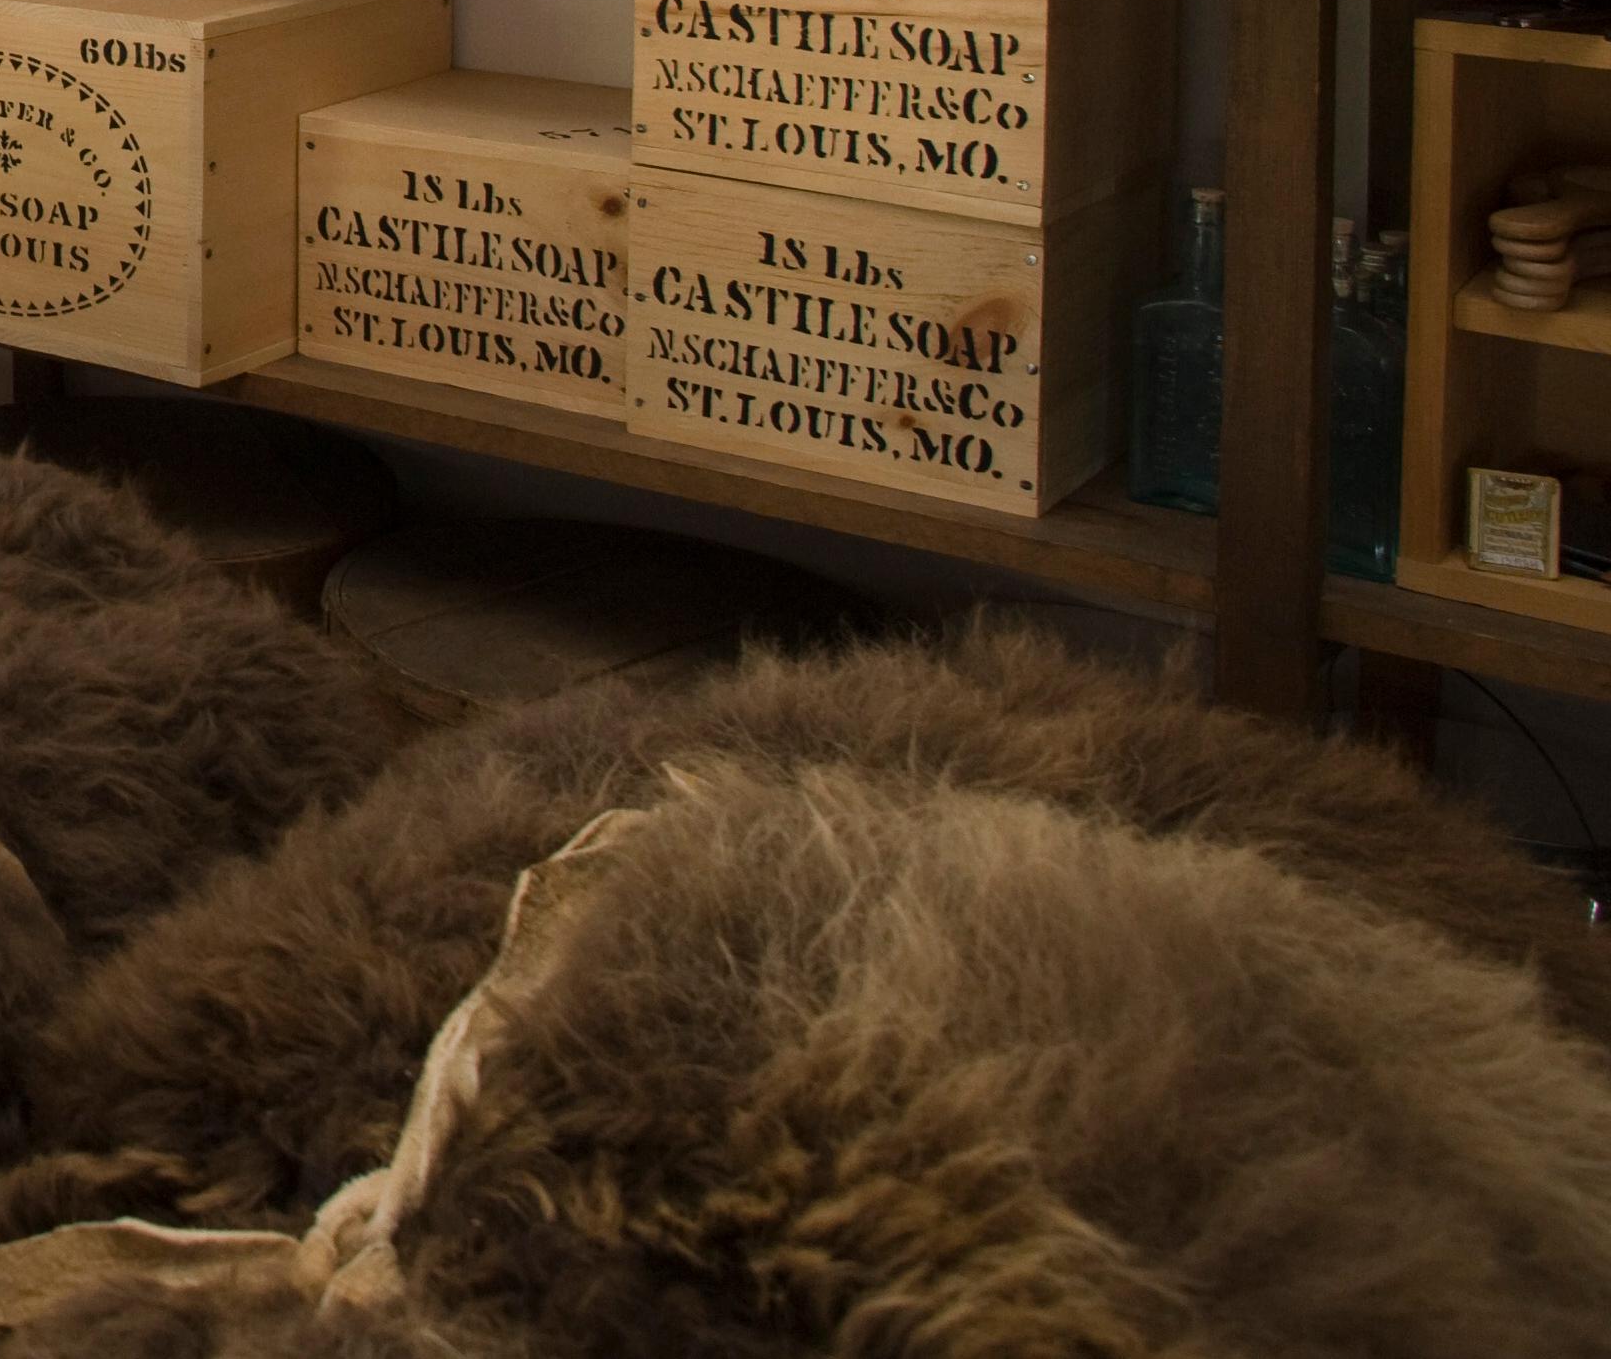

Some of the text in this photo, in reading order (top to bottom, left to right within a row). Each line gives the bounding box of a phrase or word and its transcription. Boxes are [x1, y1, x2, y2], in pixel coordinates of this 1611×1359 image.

[889, 21, 1020, 77] SOAP
[60, 127, 76, 147] &
[916, 138, 1009, 185] MO.
[402, 169, 524, 219] 18 Lbs
[317, 205, 617, 293] CASTILE SOAP
[757, 231, 905, 292] 18 Lbs
[651, 265, 1018, 376] CASTILE SOAP
[535, 337, 611, 386] MO.
[912, 427, 1004, 480] MO.
